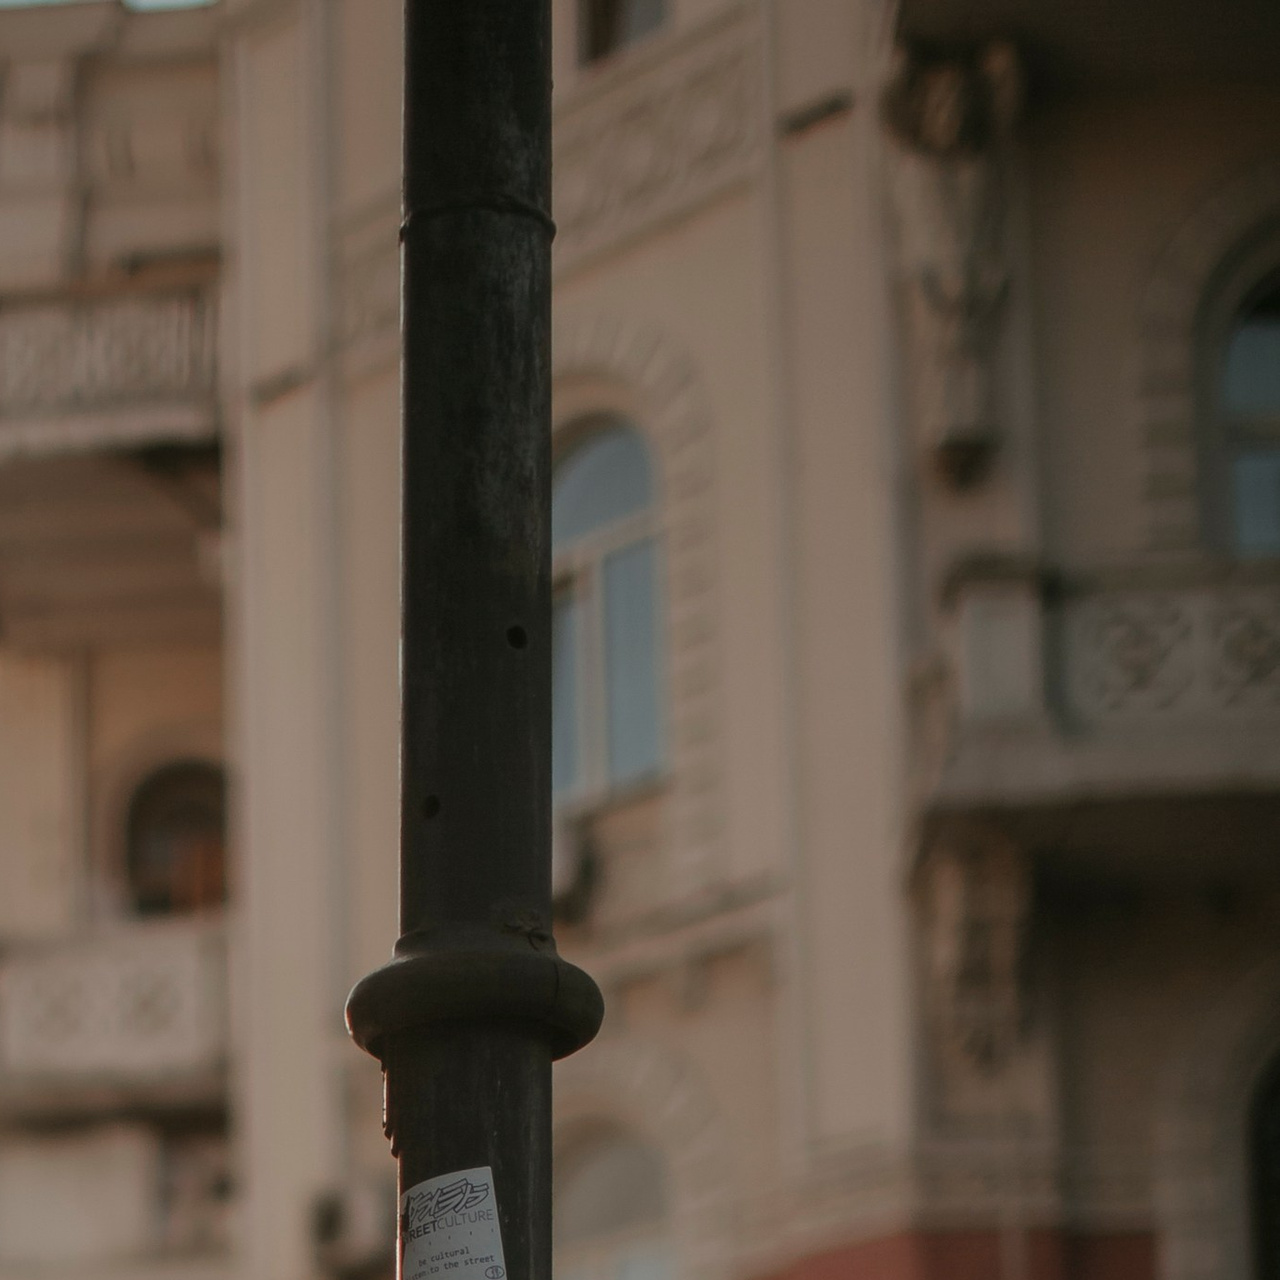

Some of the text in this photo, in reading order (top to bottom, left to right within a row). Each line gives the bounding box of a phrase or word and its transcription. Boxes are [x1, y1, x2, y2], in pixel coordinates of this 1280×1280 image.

[431, 1246, 470, 1262] cultural
[444, 1259, 459, 1270] the
[464, 1255, 495, 1266] street
